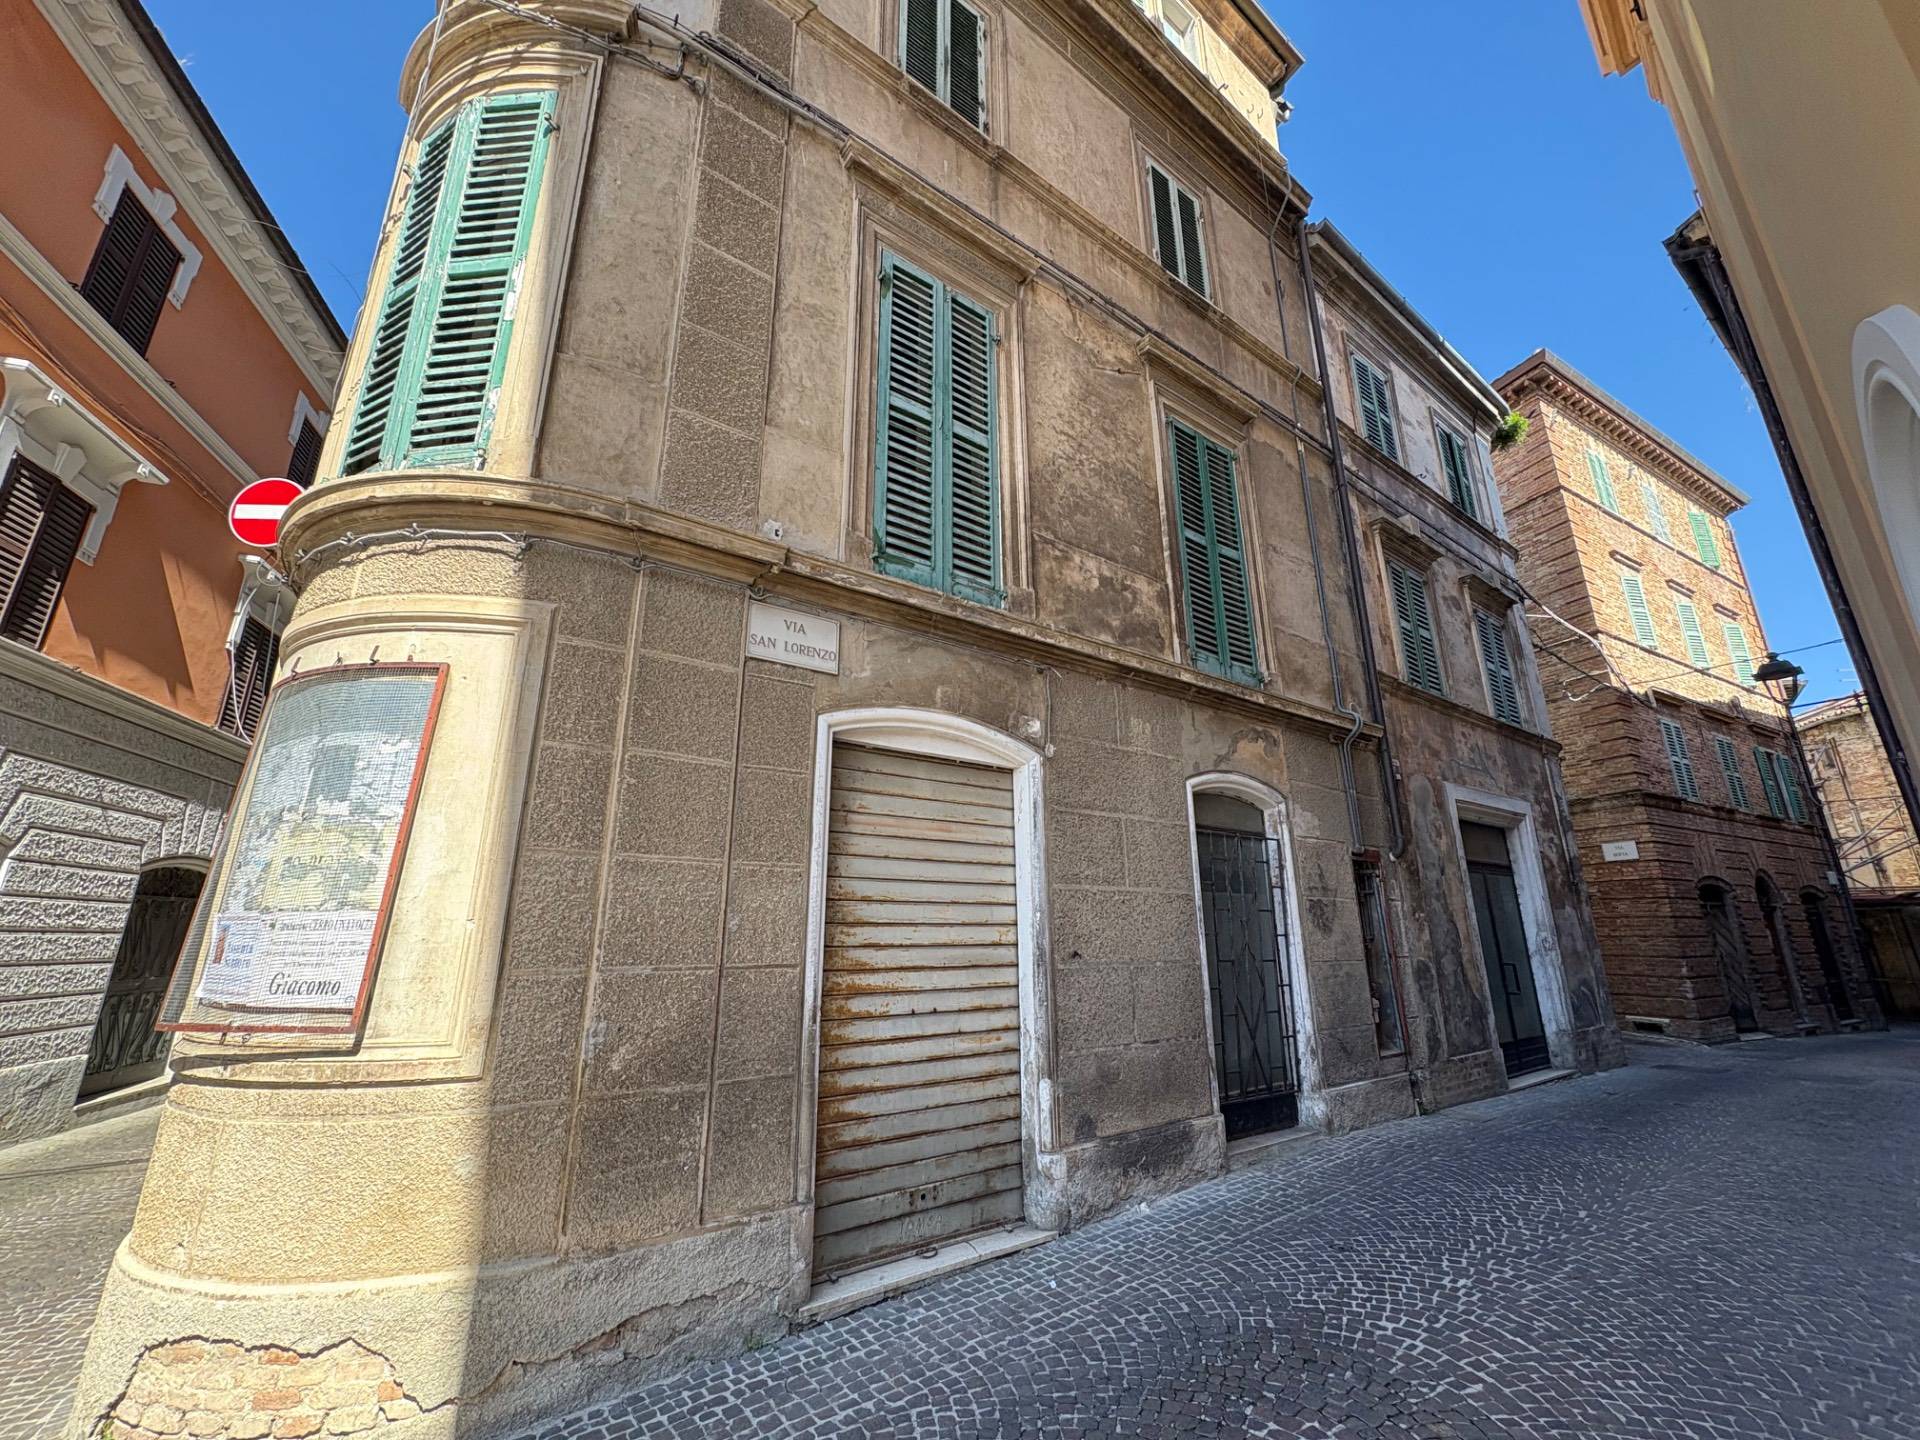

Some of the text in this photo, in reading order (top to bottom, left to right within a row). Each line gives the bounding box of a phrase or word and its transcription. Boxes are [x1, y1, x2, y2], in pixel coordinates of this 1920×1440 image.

[783, 619, 806, 635] VIA
[750, 633, 837, 662] SAN LORENZO
[269, 971, 341, 996] Giacomo
